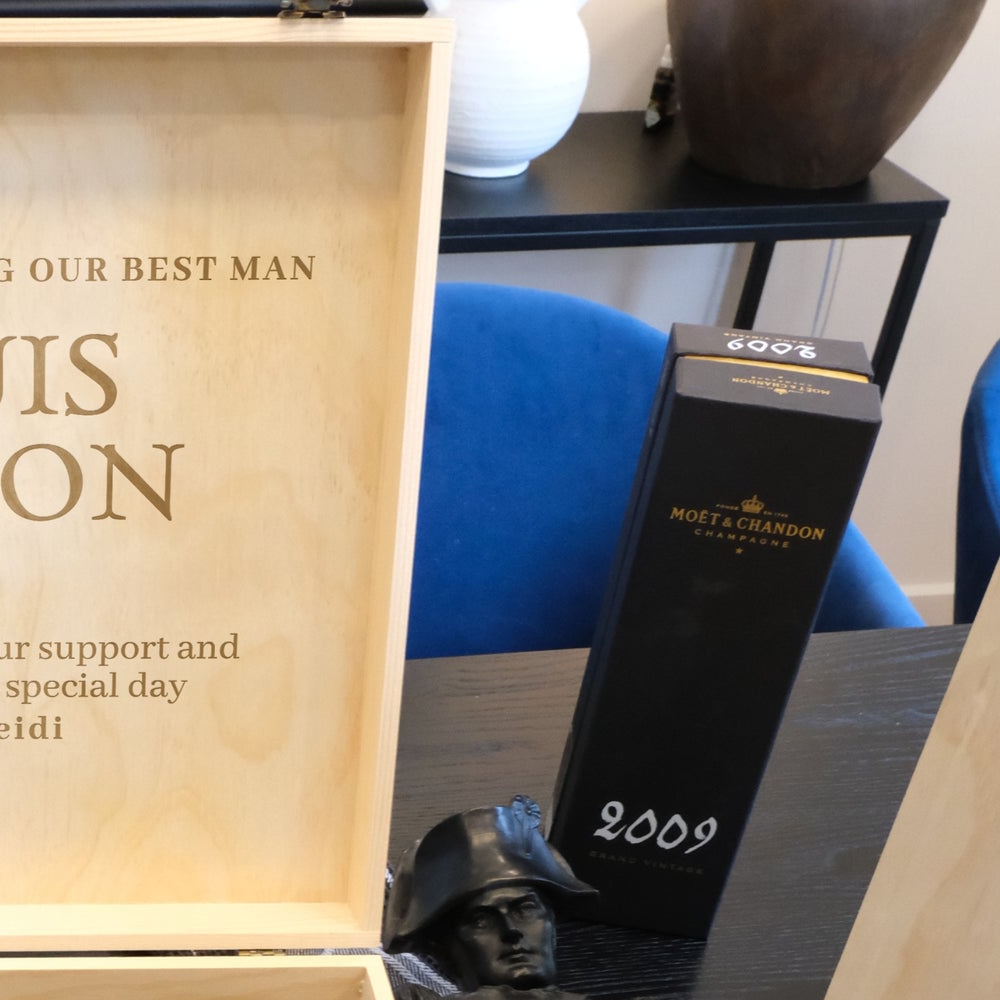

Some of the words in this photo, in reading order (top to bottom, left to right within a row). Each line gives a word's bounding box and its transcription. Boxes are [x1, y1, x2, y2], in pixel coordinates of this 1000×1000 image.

[29, 257, 108, 283] OUR
[121, 256, 217, 282] BEST
[229, 255, 316, 281] MAN
[727, 337, 817, 360] 2009
[694, 528, 790, 548] CHAMPAGNE
[722, 517, 732, 528] &
[736, 516, 825, 541] CHANDON
[38, 637, 170, 667] support
[177, 632, 240, 660] and
[6, 671, 119, 705] special
[128, 671, 188, 705] day
[593, 800, 718, 854] 2009
